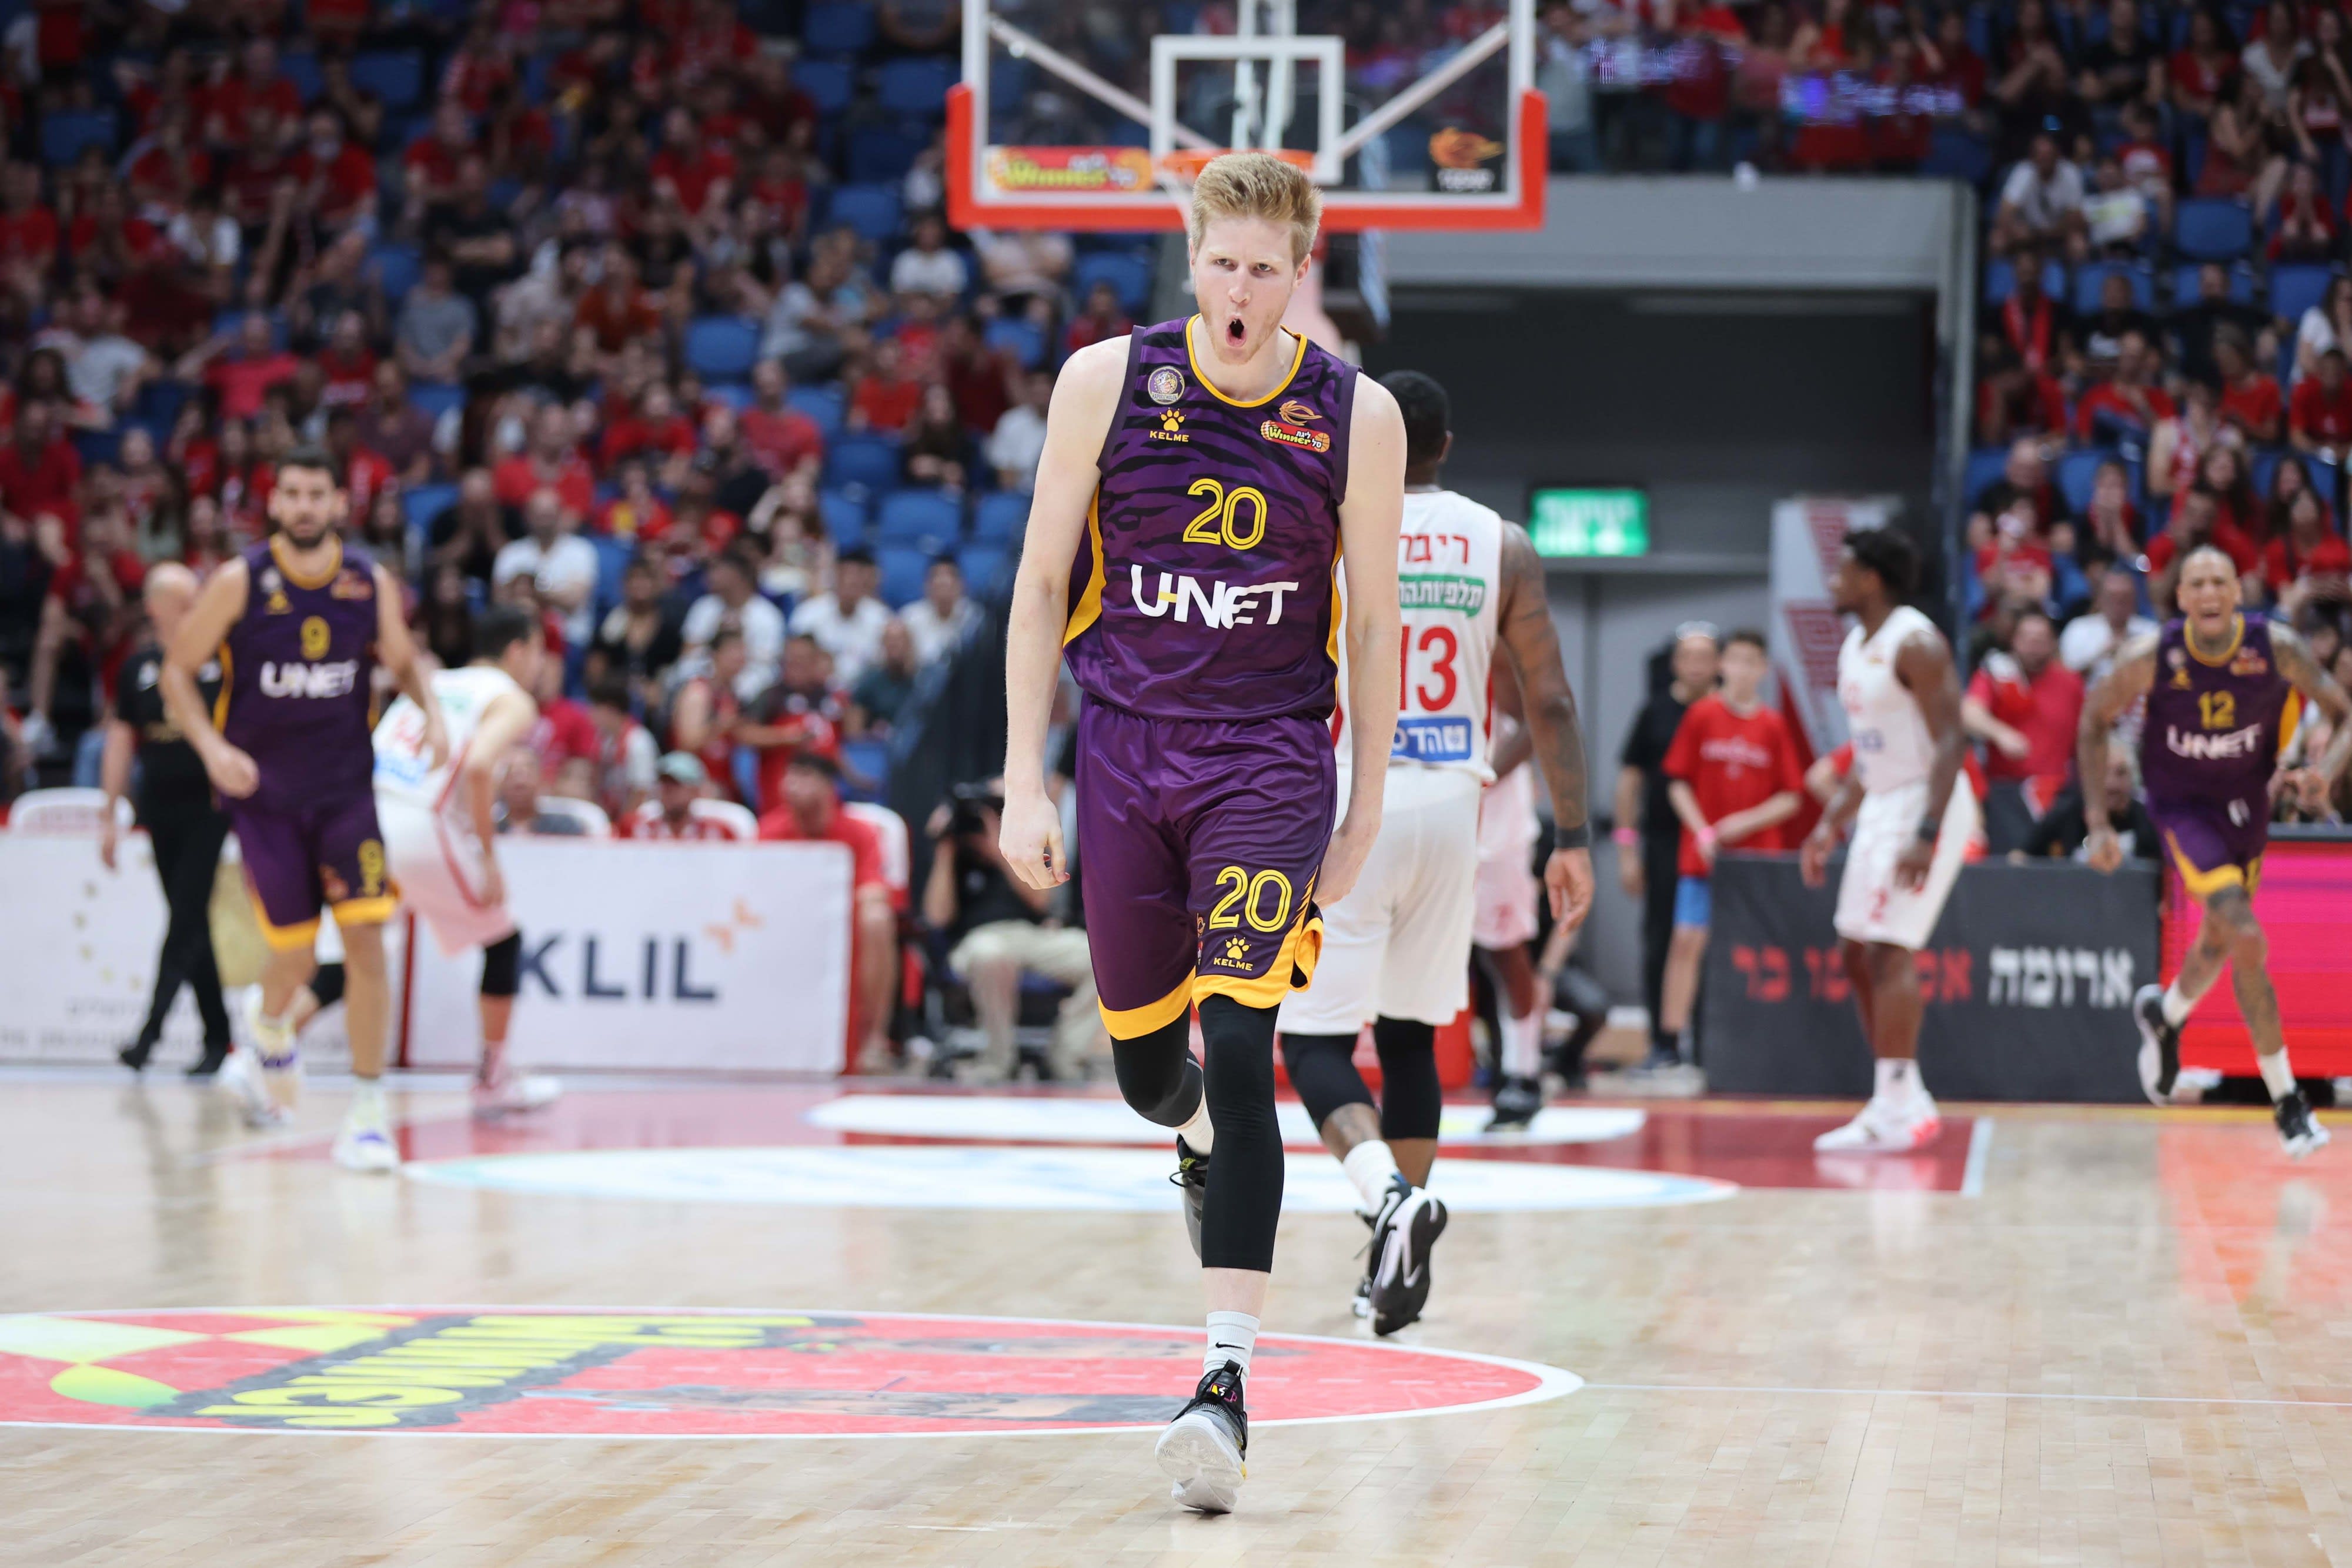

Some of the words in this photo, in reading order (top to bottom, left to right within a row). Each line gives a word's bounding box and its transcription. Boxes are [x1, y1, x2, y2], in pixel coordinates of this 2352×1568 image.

[1150, 431, 1189, 442] KELME
[1268, 426, 1311, 445] Winner
[1295, 430, 1311, 439] ליגת
[1311, 438, 1322, 448] סל
[1182, 478, 1267, 550] 20
[1130, 564, 1298, 629] UNET
[300, 616, 331, 661] 9
[260, 660, 359, 698] UNET
[2198, 690, 2236, 730] 12
[2167, 723, 2261, 760] UNET
[1209, 865, 1292, 932] 20
[519, 932, 717, 1002] KLIL
[1214, 957, 1253, 971] KELME
[1989, 945, 2134, 1008] ארומה
